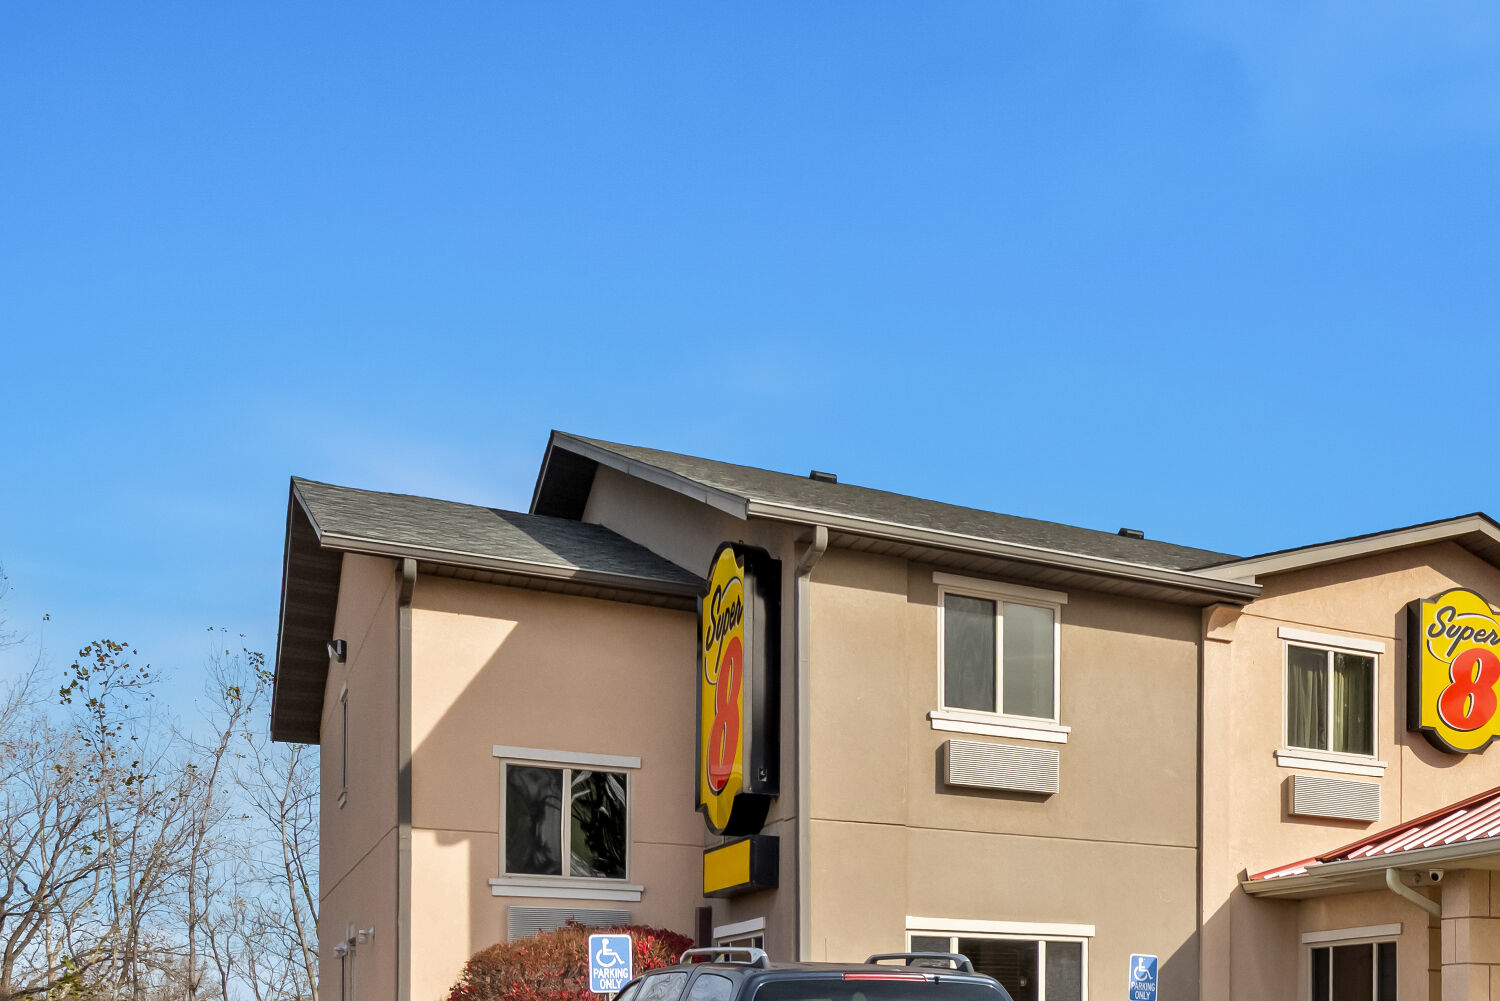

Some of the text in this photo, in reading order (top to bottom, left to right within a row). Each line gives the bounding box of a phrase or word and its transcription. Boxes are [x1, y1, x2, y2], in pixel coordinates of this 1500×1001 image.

[705, 584, 743, 674] Super
[707, 636, 743, 797] 8
[593, 968, 629, 978] PARKING
[601, 979, 622, 989] ONLY
[1131, 981, 1156, 991] PARKING
[1135, 991, 1150, 1000] ONLY
